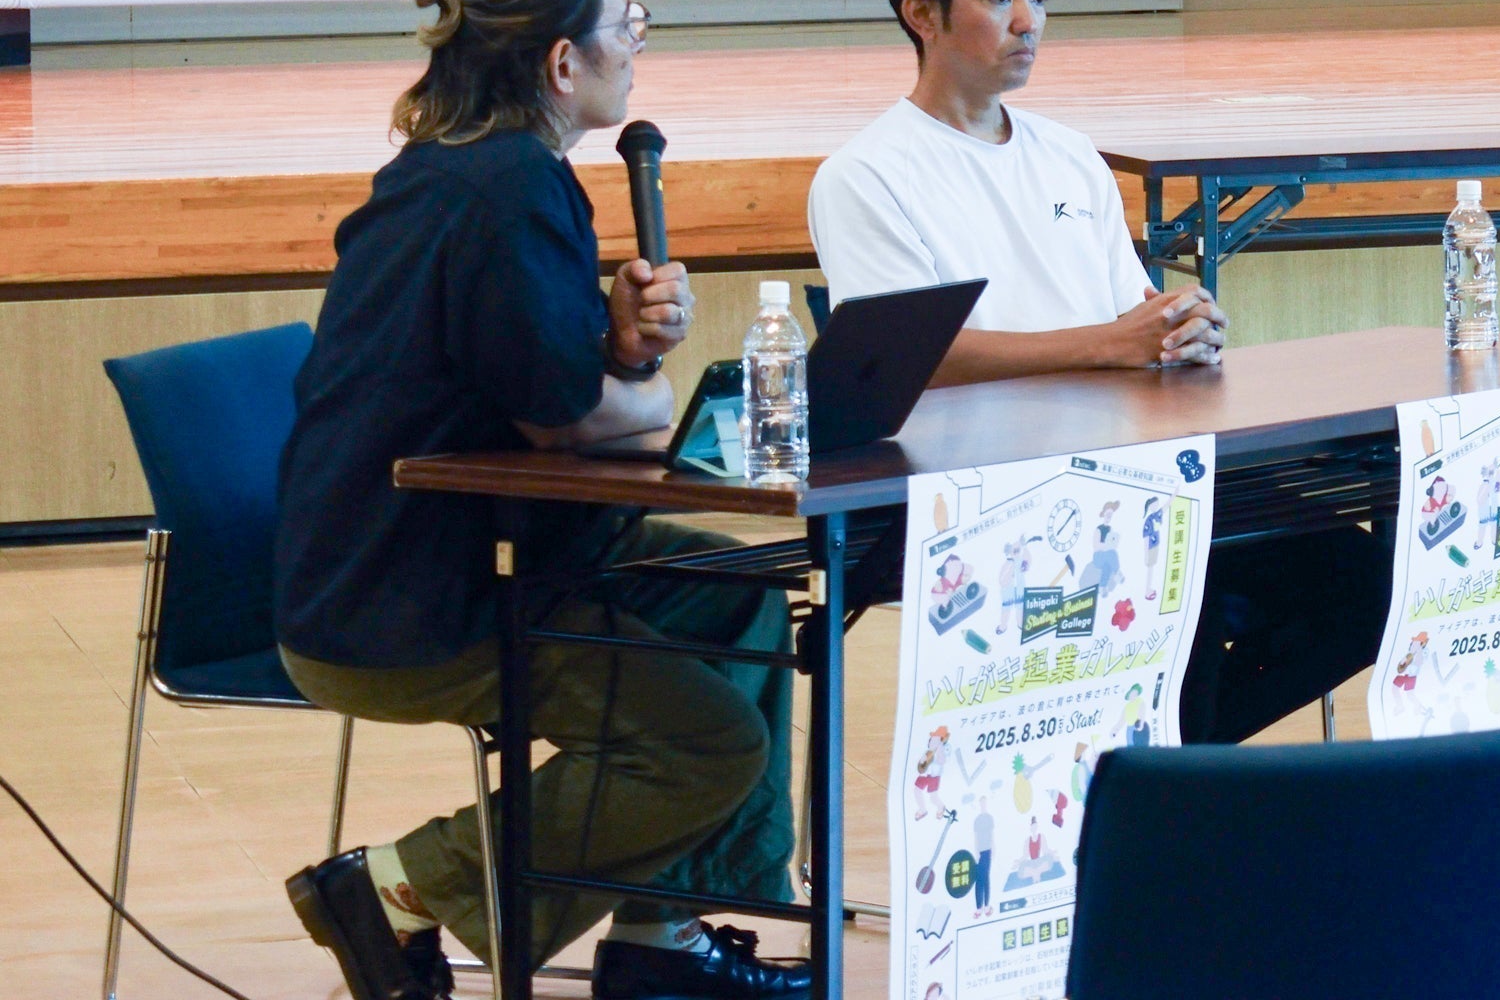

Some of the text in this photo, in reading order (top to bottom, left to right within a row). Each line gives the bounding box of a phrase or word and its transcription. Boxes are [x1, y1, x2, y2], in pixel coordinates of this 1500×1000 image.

[1026, 594, 1059, 610] Ishigaki
[926, 624, 1175, 709] いしがき起業ガレッジ
[976, 717, 1057, 753] 2025.8.30
